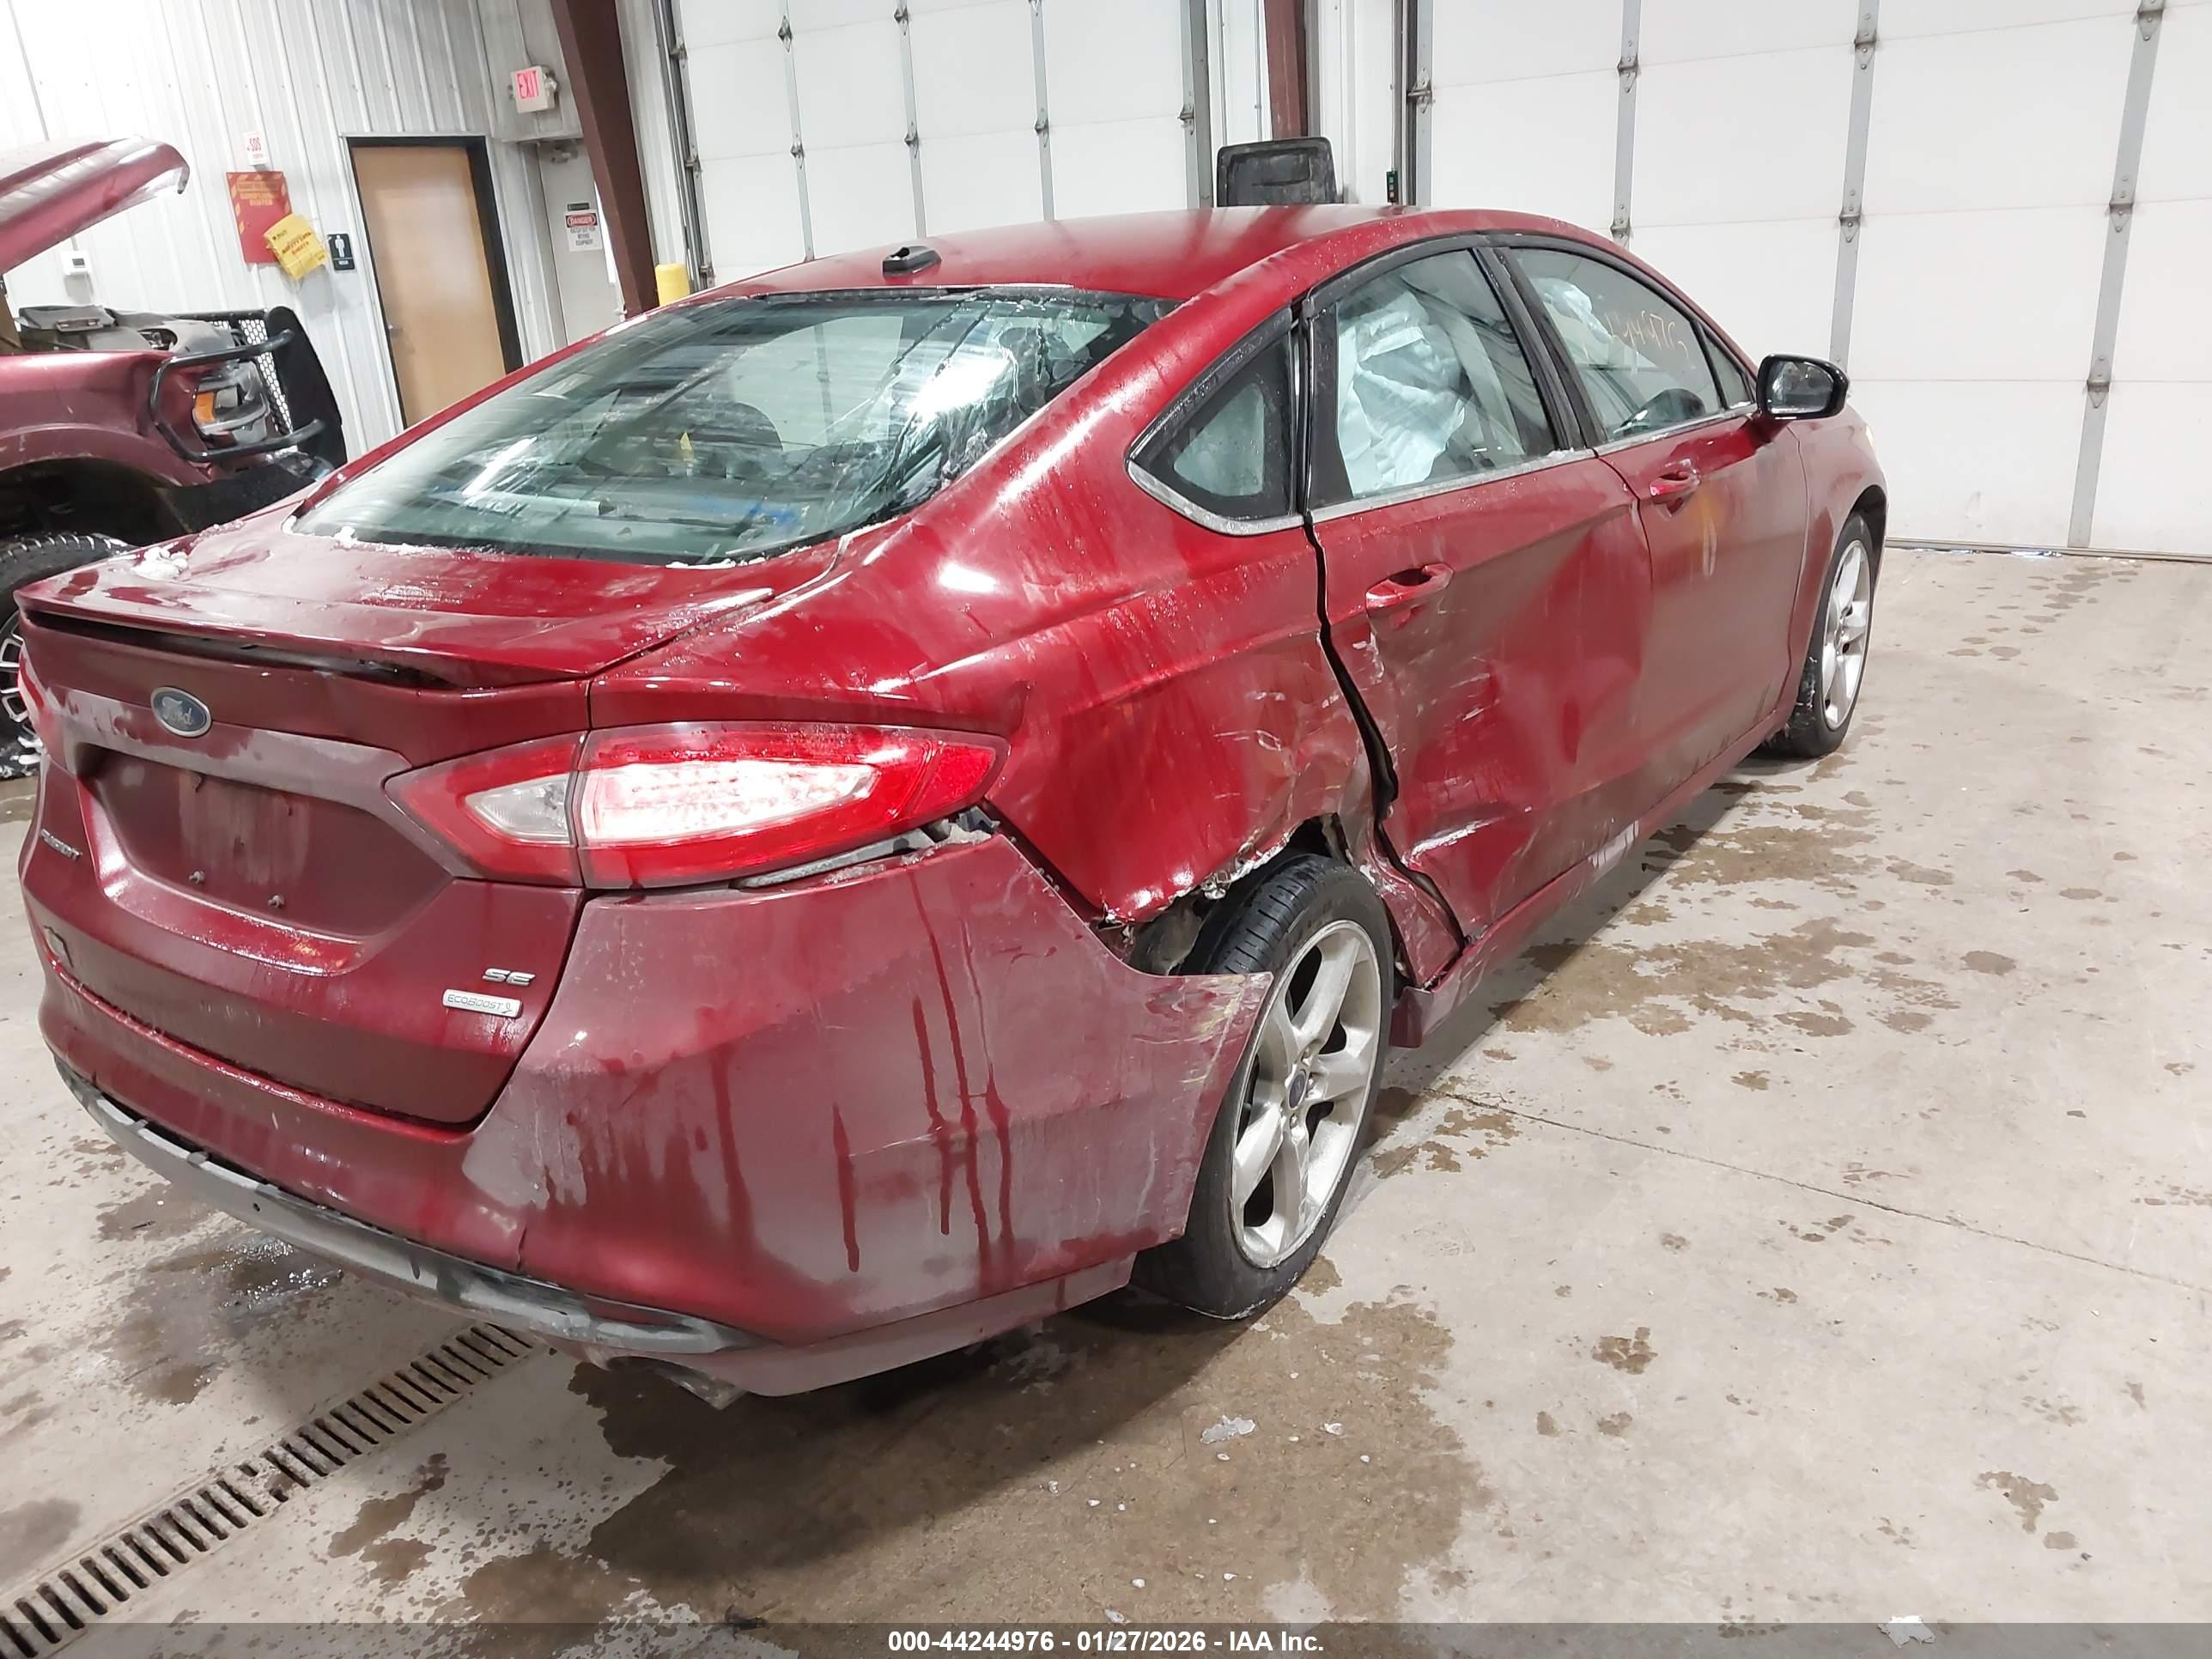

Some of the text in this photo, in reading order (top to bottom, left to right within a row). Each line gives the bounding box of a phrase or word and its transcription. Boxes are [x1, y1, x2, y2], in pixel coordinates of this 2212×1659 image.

[517, 70, 539, 99] EXIT
[570, 216, 593, 226] DANGER
[482, 968, 537, 987] SE
